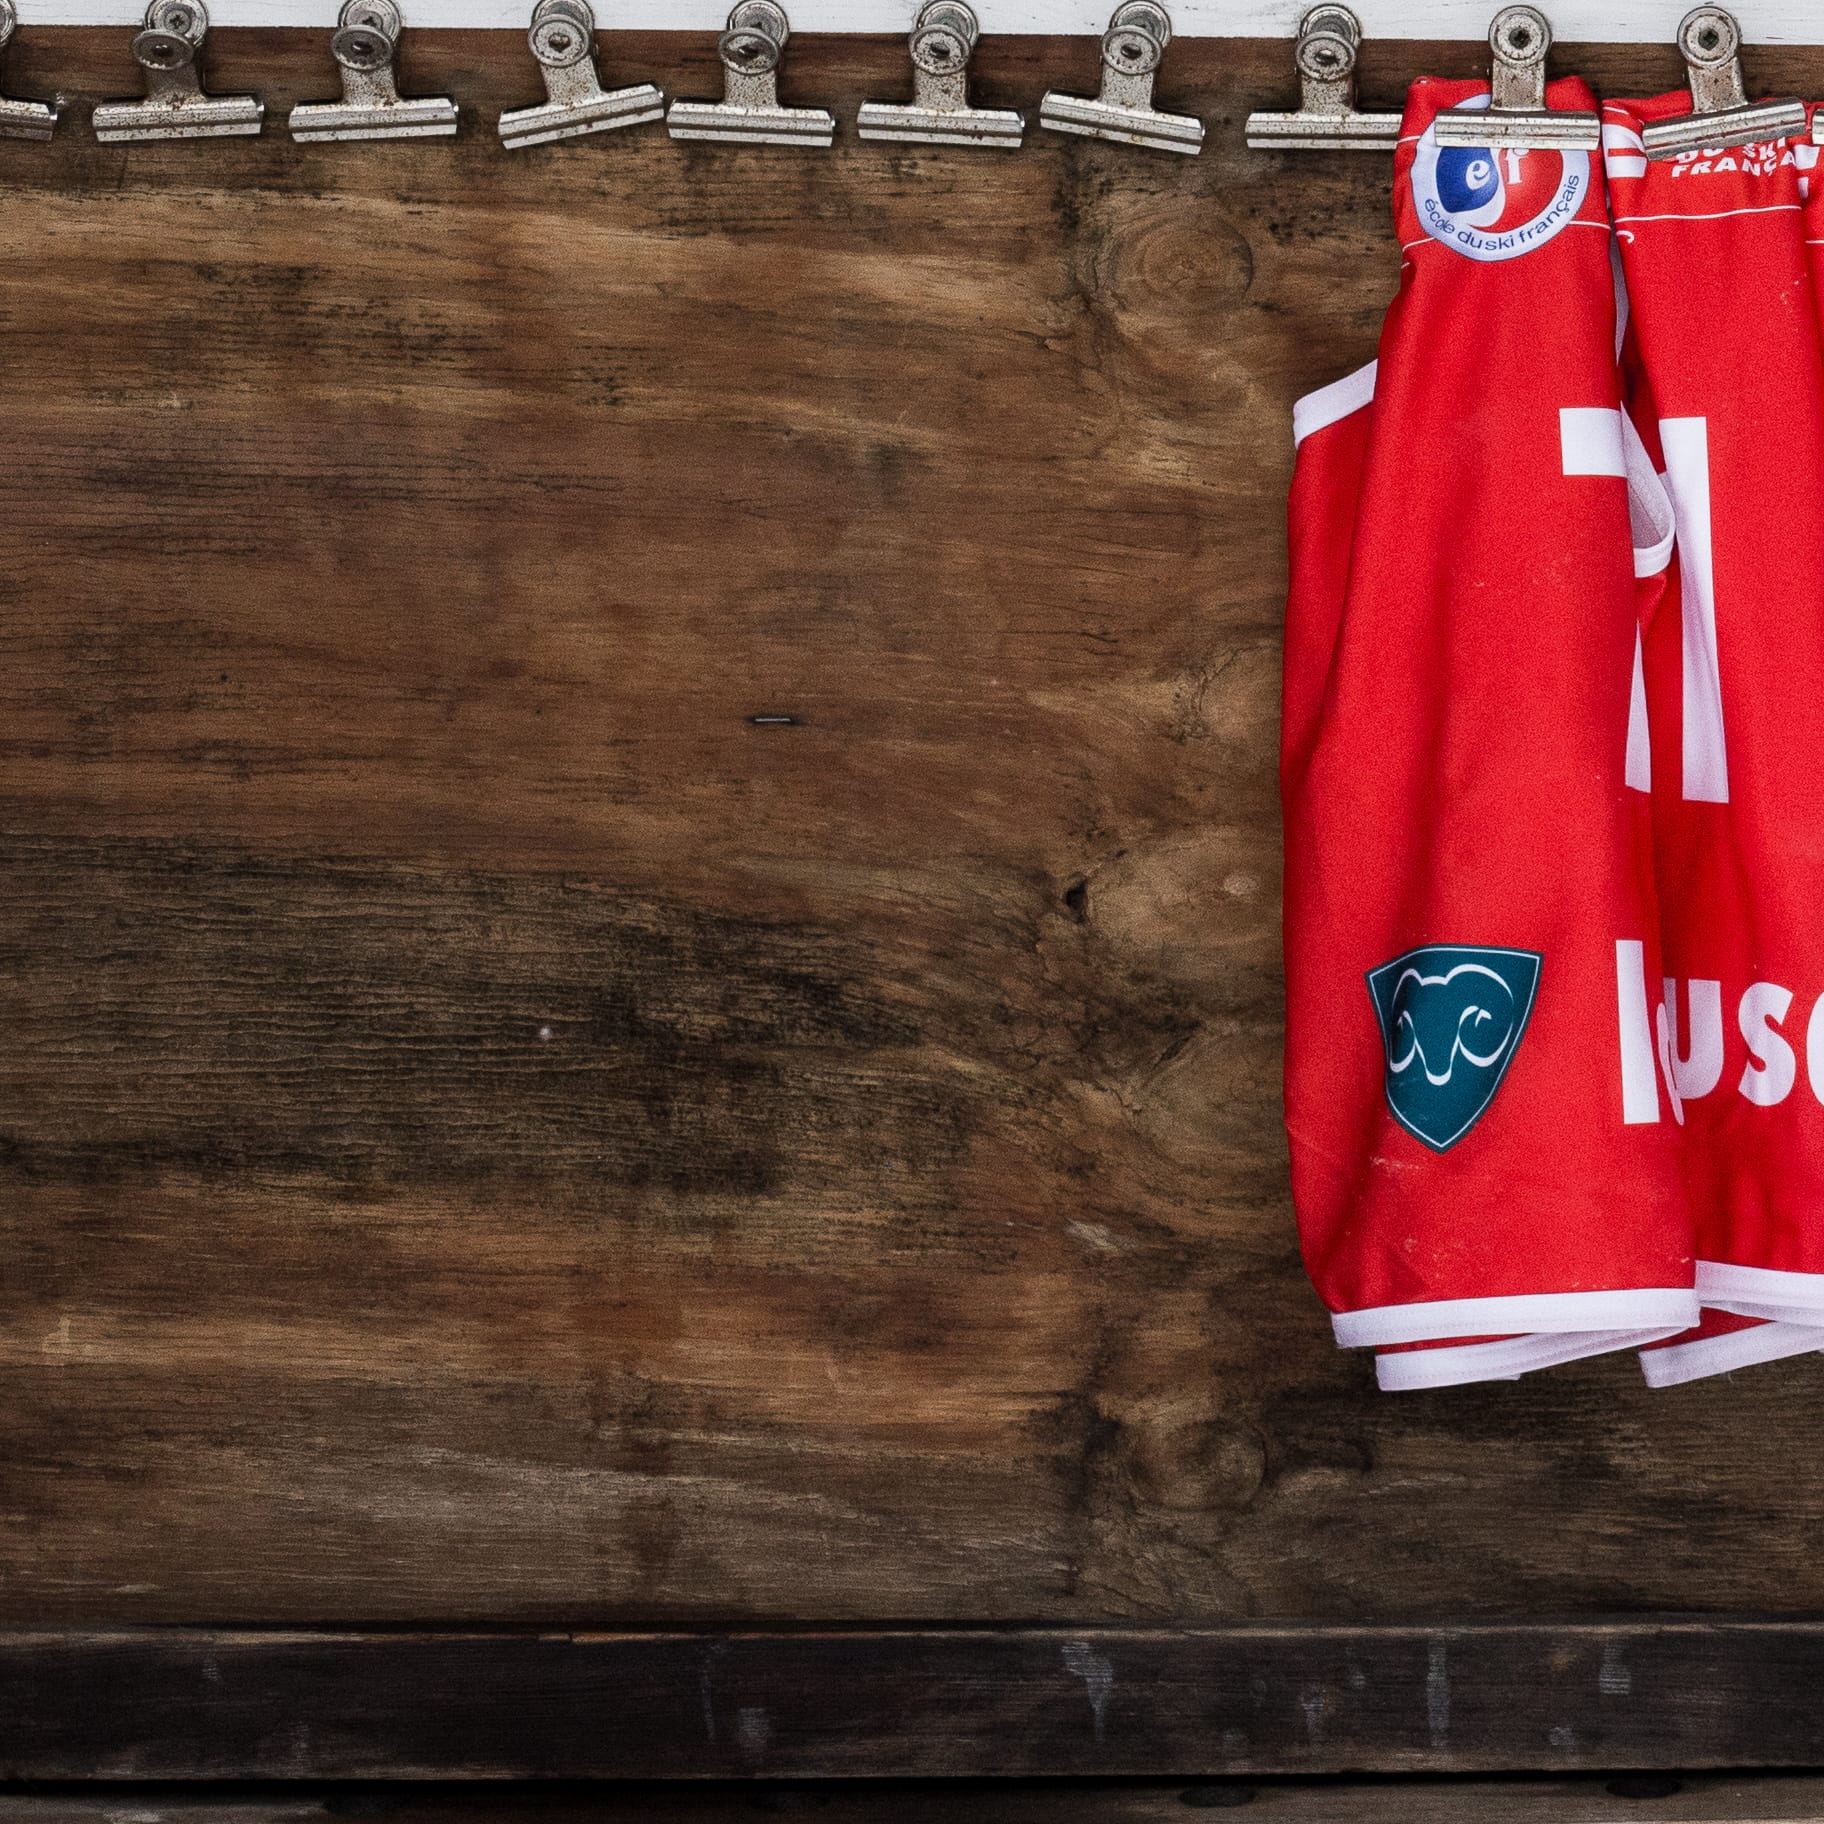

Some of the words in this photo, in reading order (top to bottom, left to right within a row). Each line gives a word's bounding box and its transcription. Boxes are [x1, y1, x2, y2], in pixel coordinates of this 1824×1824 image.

[1424, 197, 1456, 237] école
[1456, 227, 1484, 250] du
[1484, 233, 1515, 252] ski
[1517, 173, 1581, 245] français
